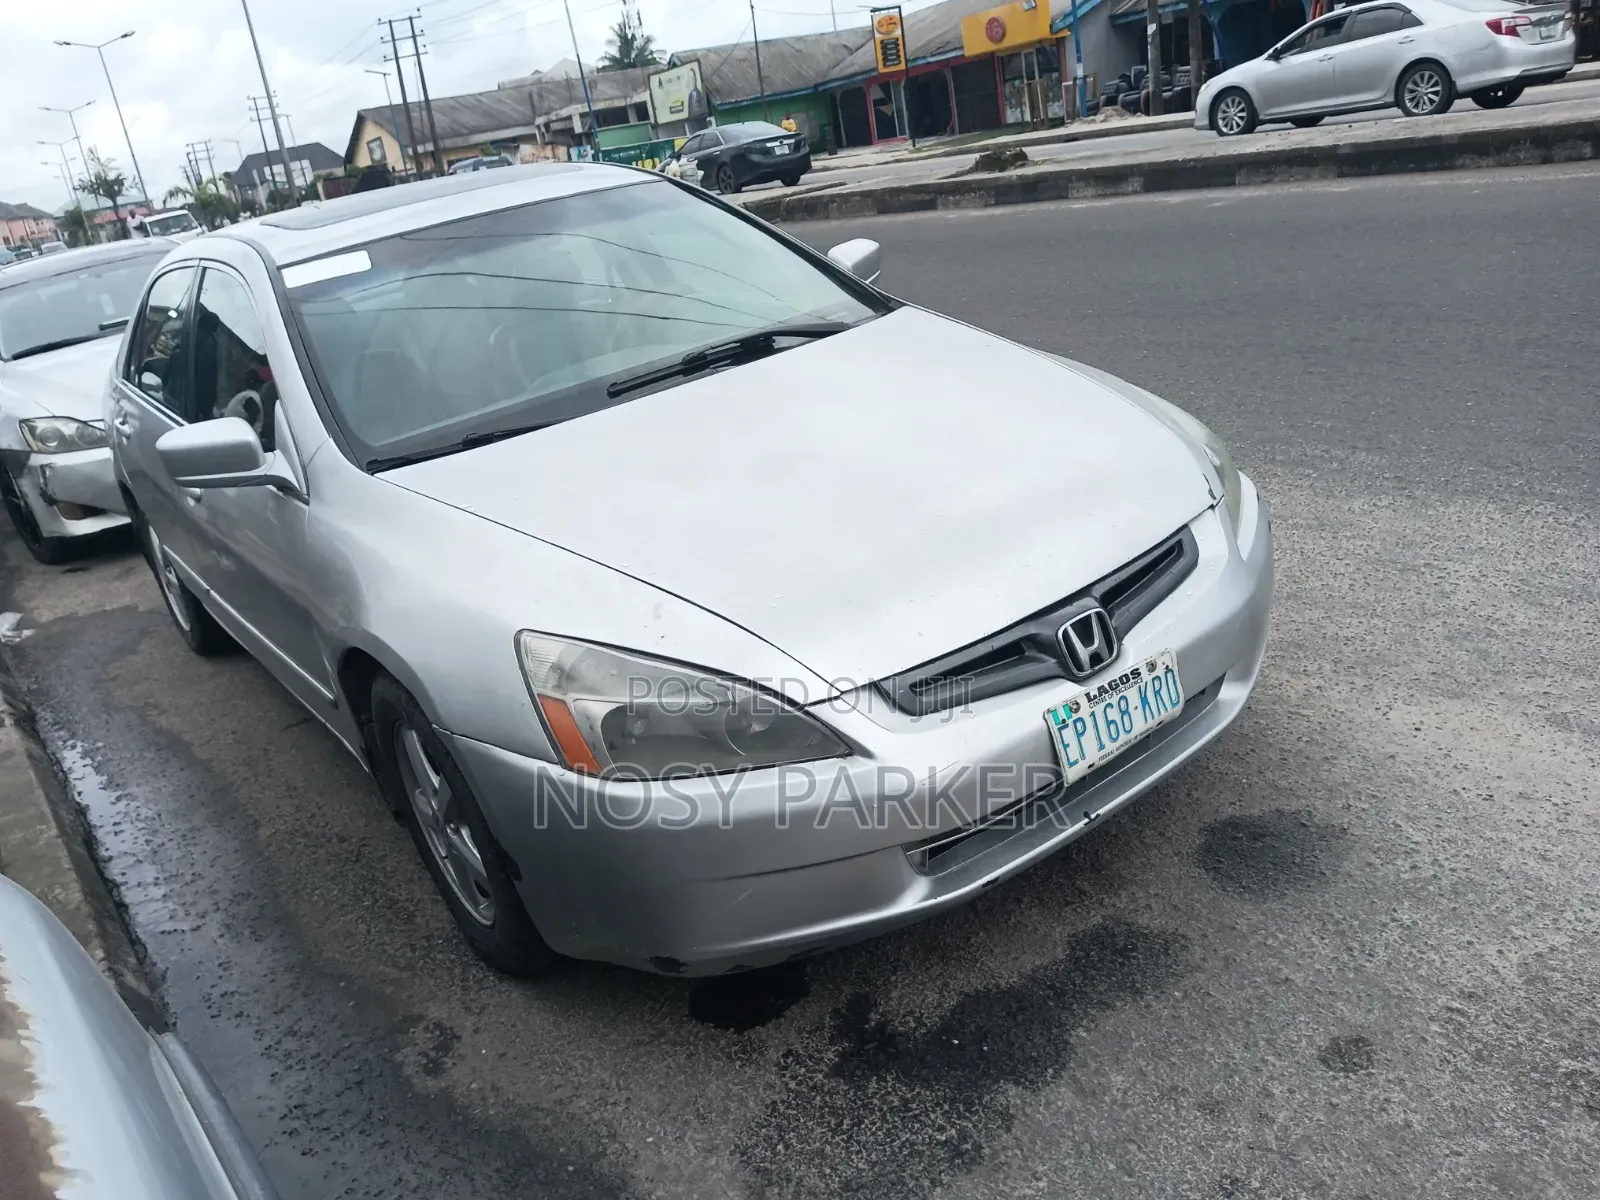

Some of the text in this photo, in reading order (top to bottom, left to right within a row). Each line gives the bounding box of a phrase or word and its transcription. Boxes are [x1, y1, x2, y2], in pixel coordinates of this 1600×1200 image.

[1084, 667, 1142, 703] LAGOS
[1088, 676, 1144, 709] CENTRE OF EXCELLENCE
